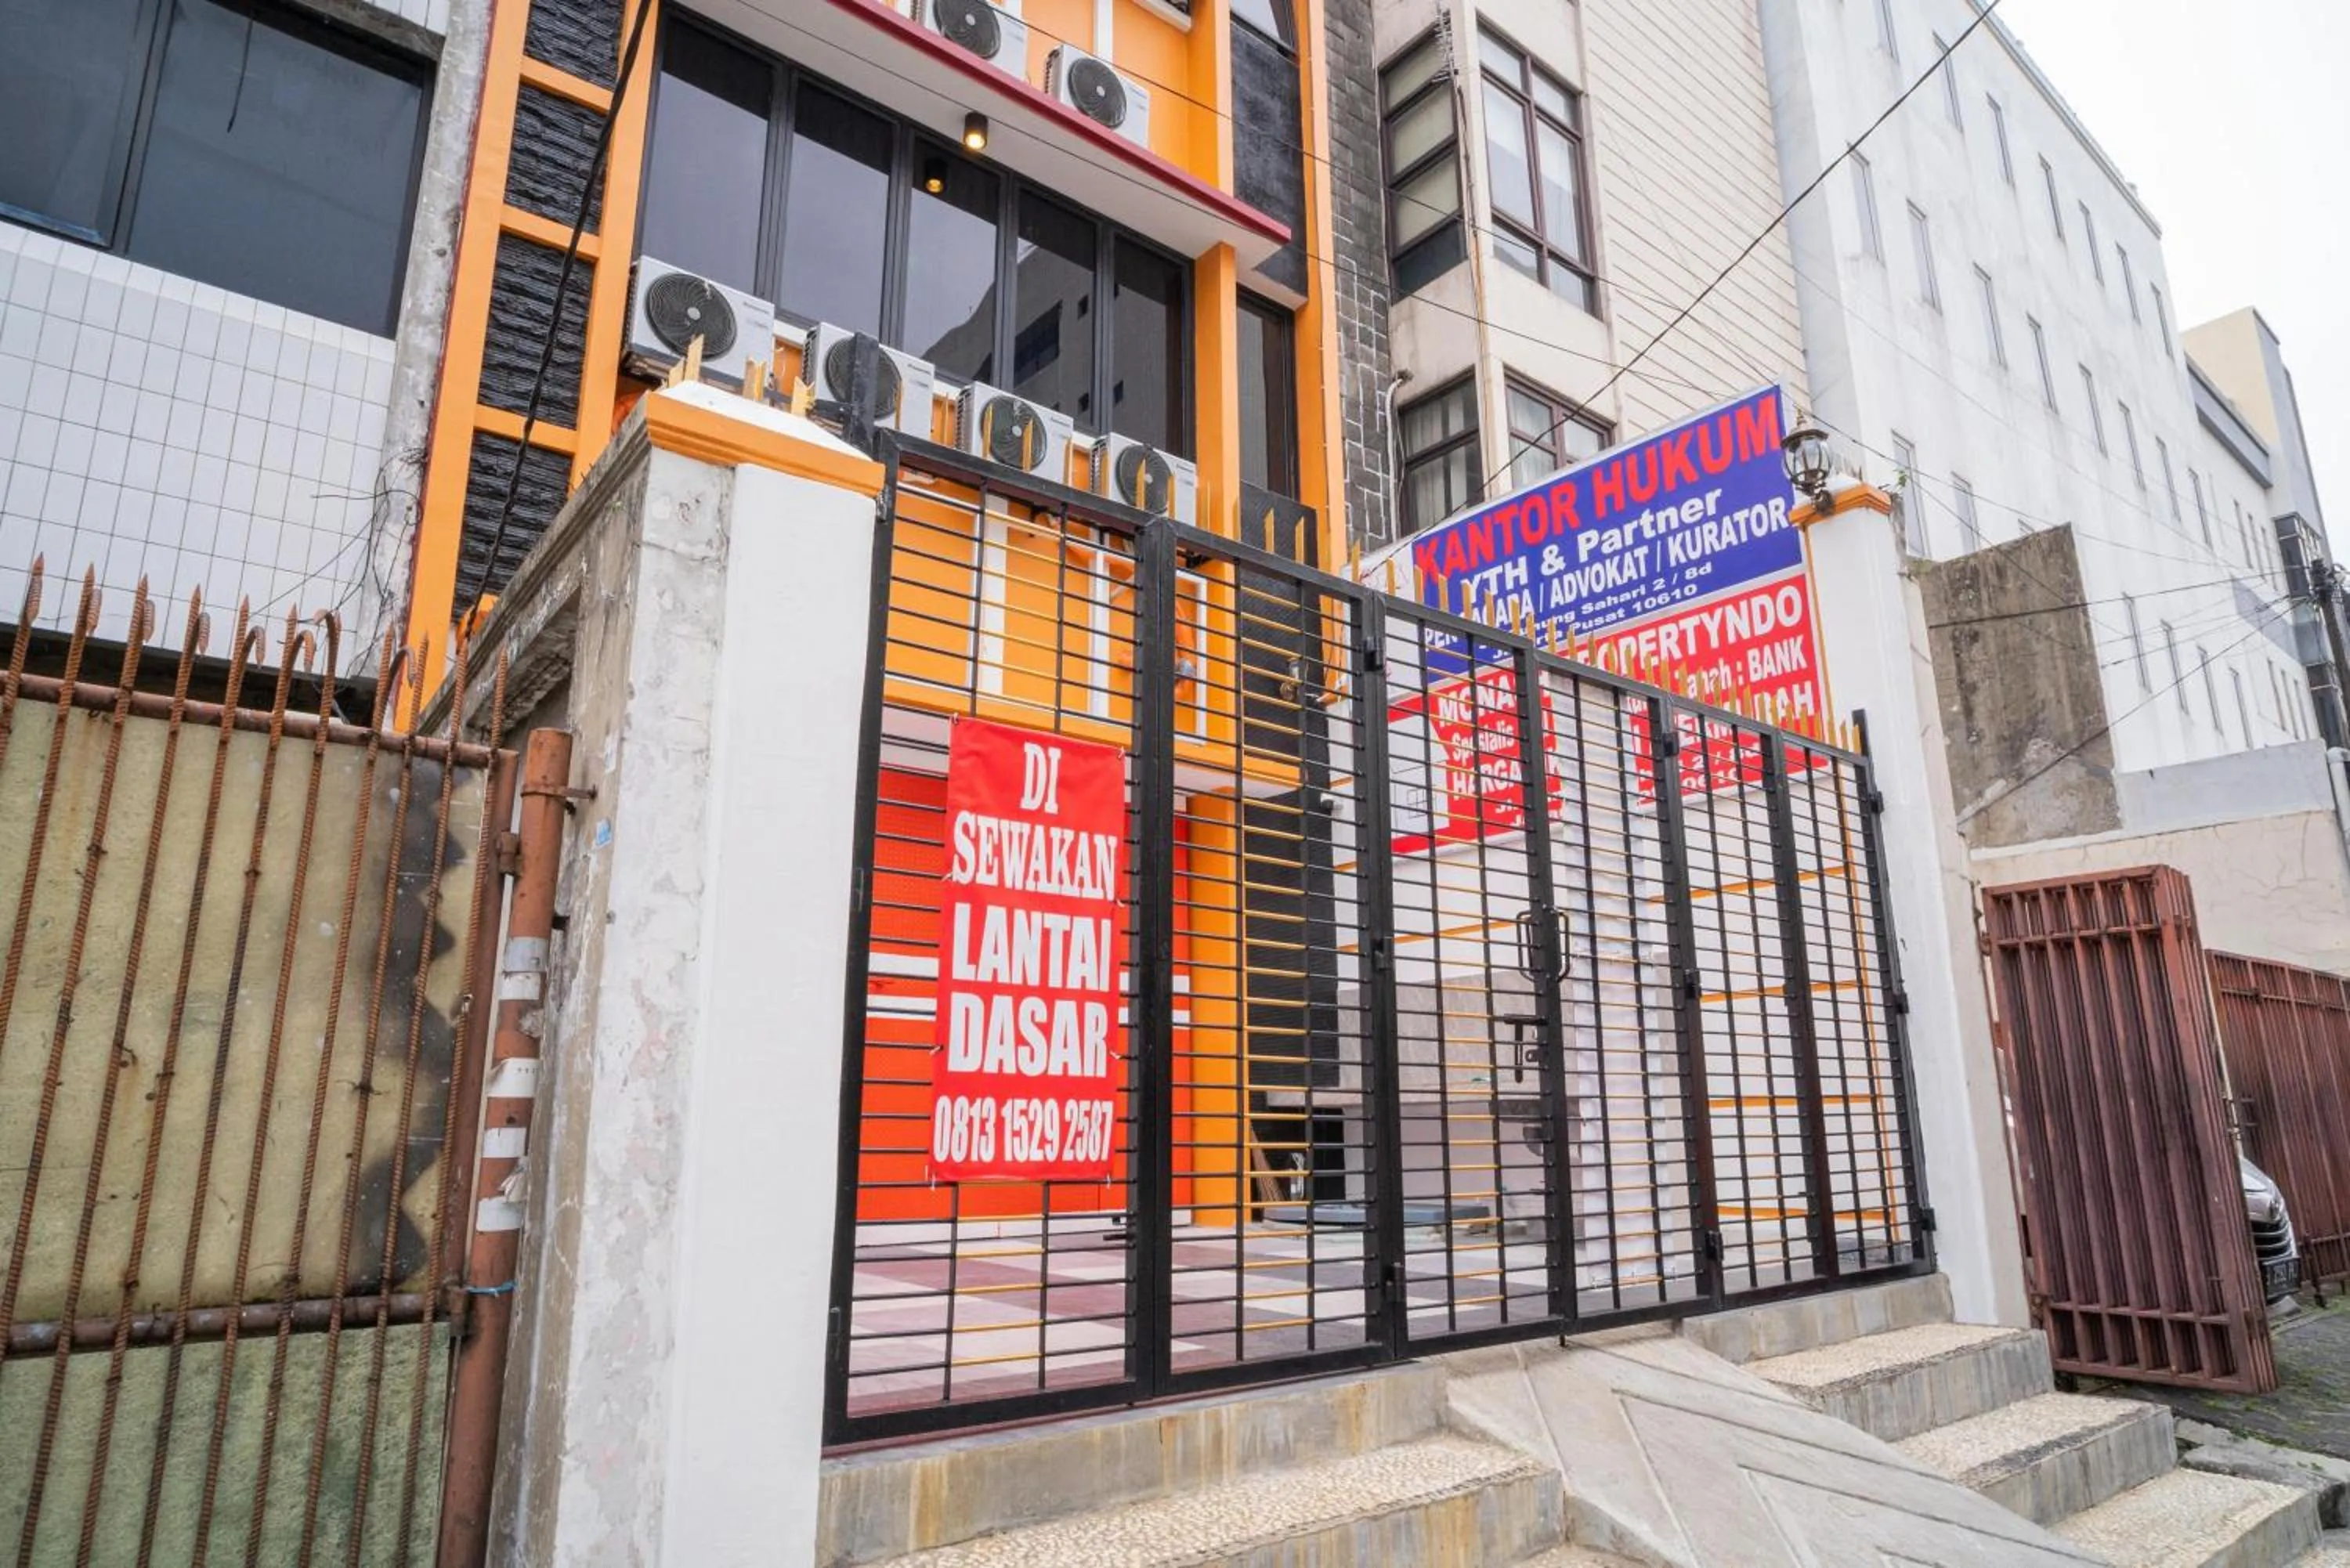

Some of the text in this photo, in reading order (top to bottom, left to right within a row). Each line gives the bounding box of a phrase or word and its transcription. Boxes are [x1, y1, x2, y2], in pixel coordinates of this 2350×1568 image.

[1414, 396, 1782, 586] KANTOR HUKUM
[1541, 544, 1567, 576] &
[1577, 488, 1723, 562] Partner
[1550, 546, 1649, 609] ADVOKAT
[1668, 497, 1790, 567] KURATOR
[1581, 584, 1646, 615] Sahari
[1652, 577, 1666, 591] 2
[1685, 562, 1712, 580] 8d
[1632, 583, 1697, 612] 10610
[1747, 635, 1808, 682] BANK
[1020, 742, 1061, 815] DI
[952, 809, 1117, 901] SEWAKAN
[952, 902, 1111, 992] LANTAI
[947, 992, 1108, 1078] DASAR
[933, 1096, 1114, 1163] 0813 1529 2587
